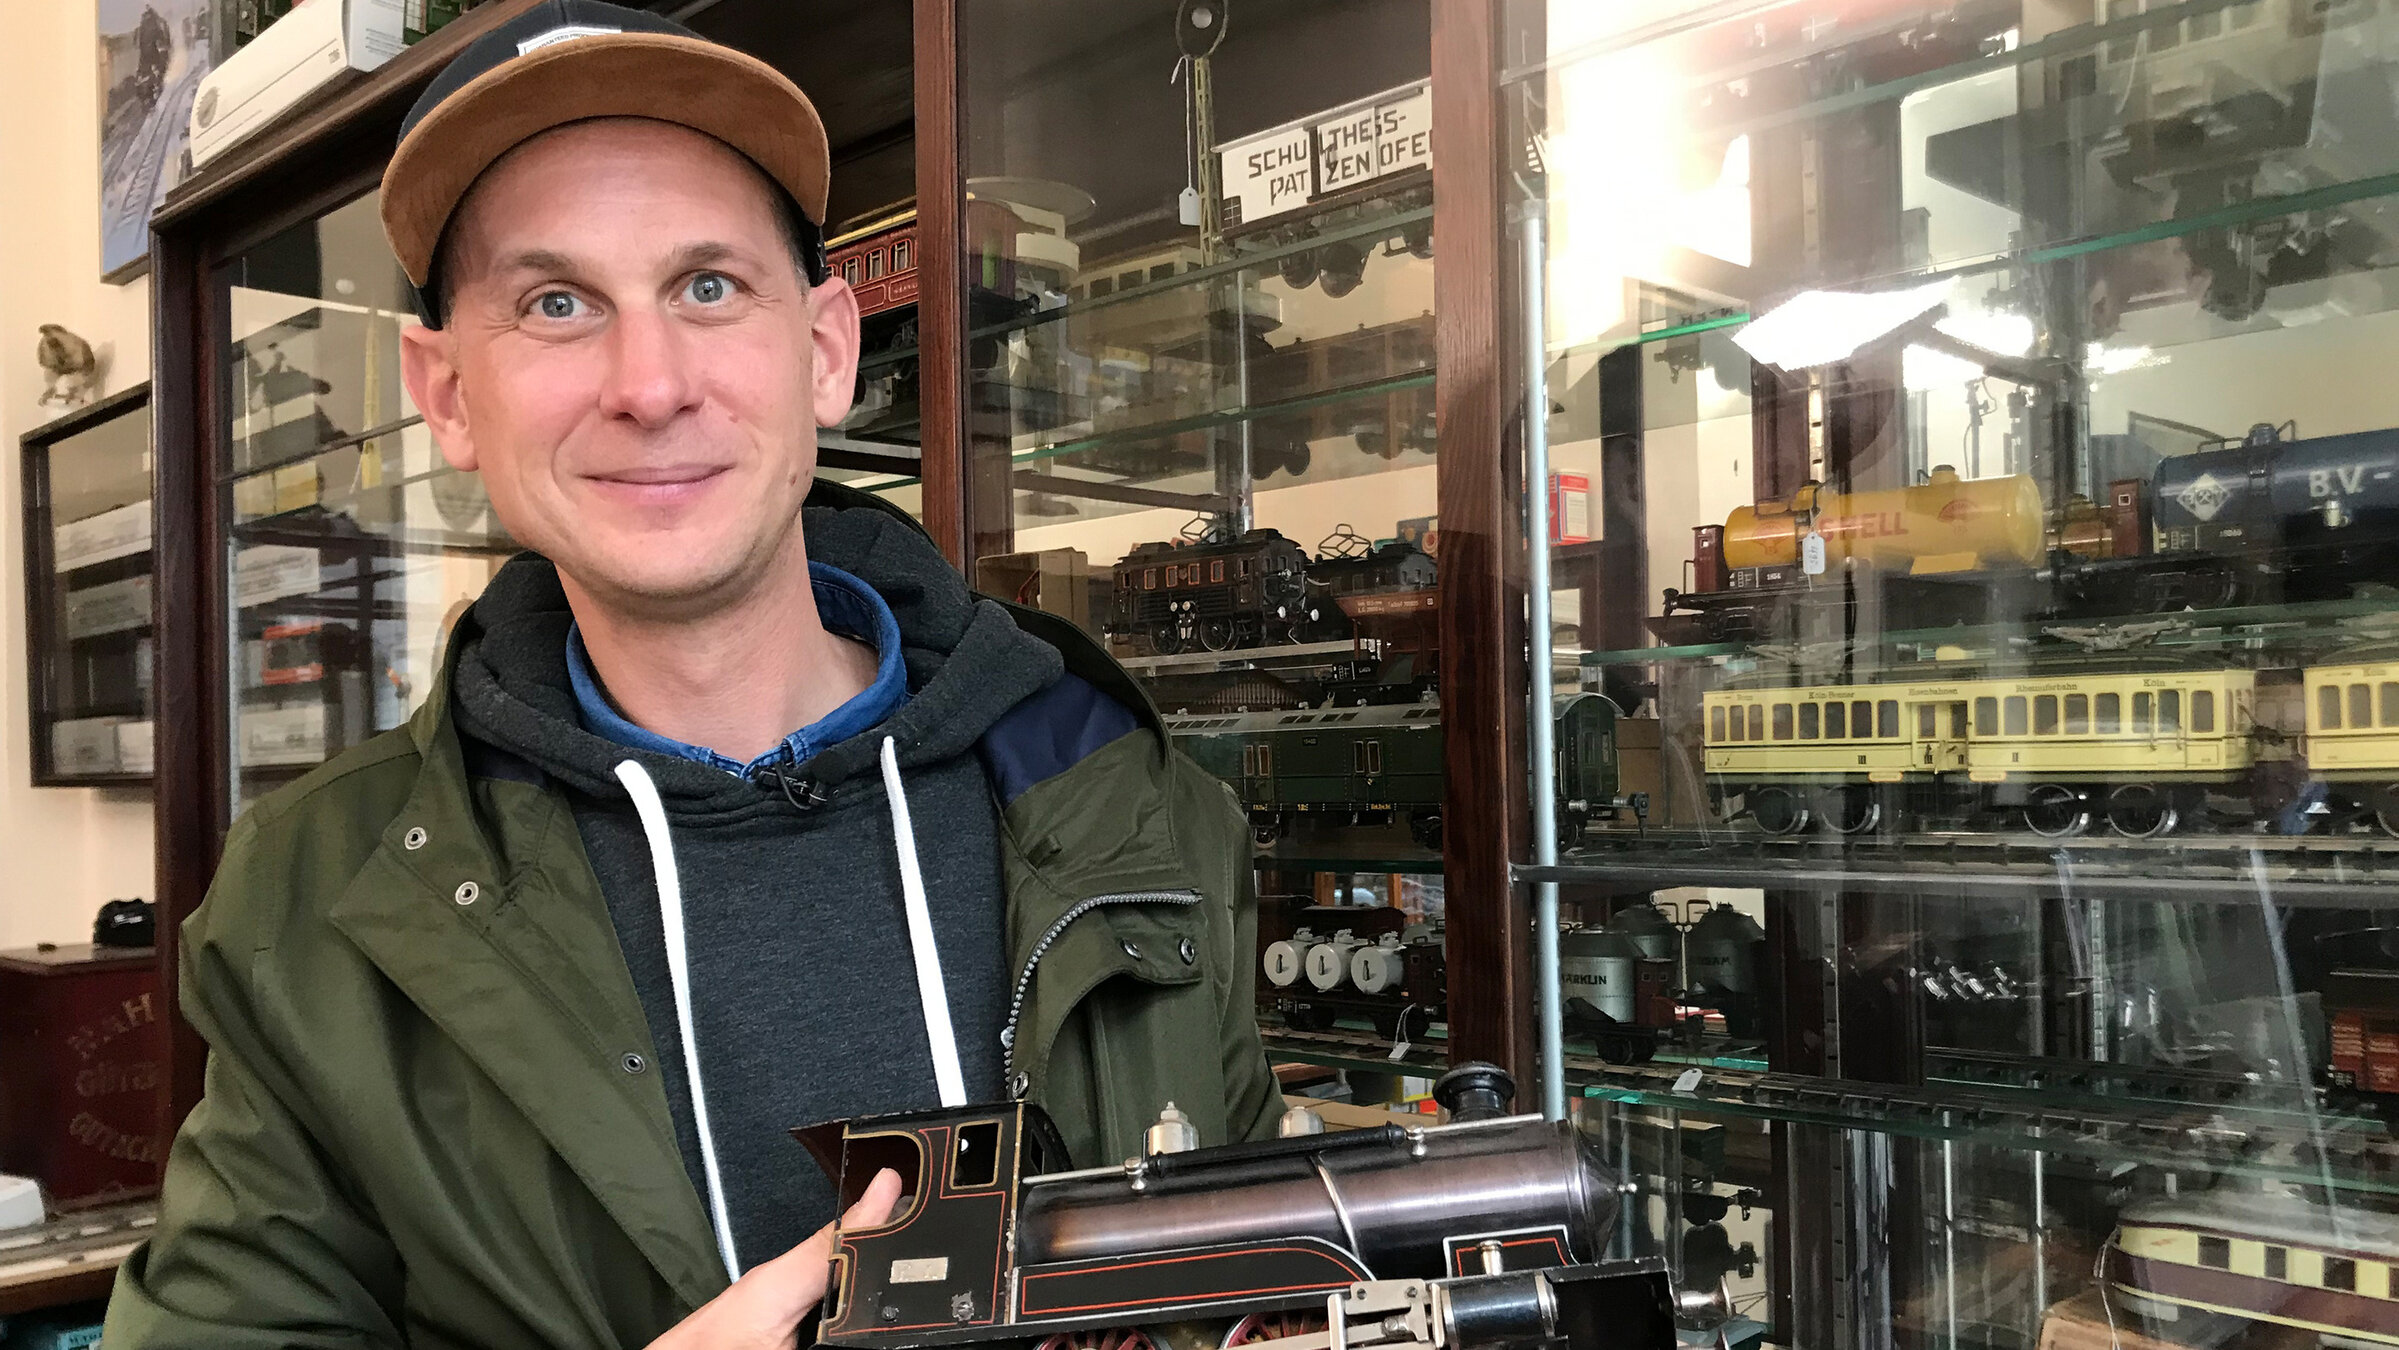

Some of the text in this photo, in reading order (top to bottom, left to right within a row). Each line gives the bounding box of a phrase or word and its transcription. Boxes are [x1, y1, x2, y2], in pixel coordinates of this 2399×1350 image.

[1817, 511, 1908, 543] SHELL
[2015, 683, 2078, 693] Rheinuferbahn
[2143, 678, 2166, 687] Köln
